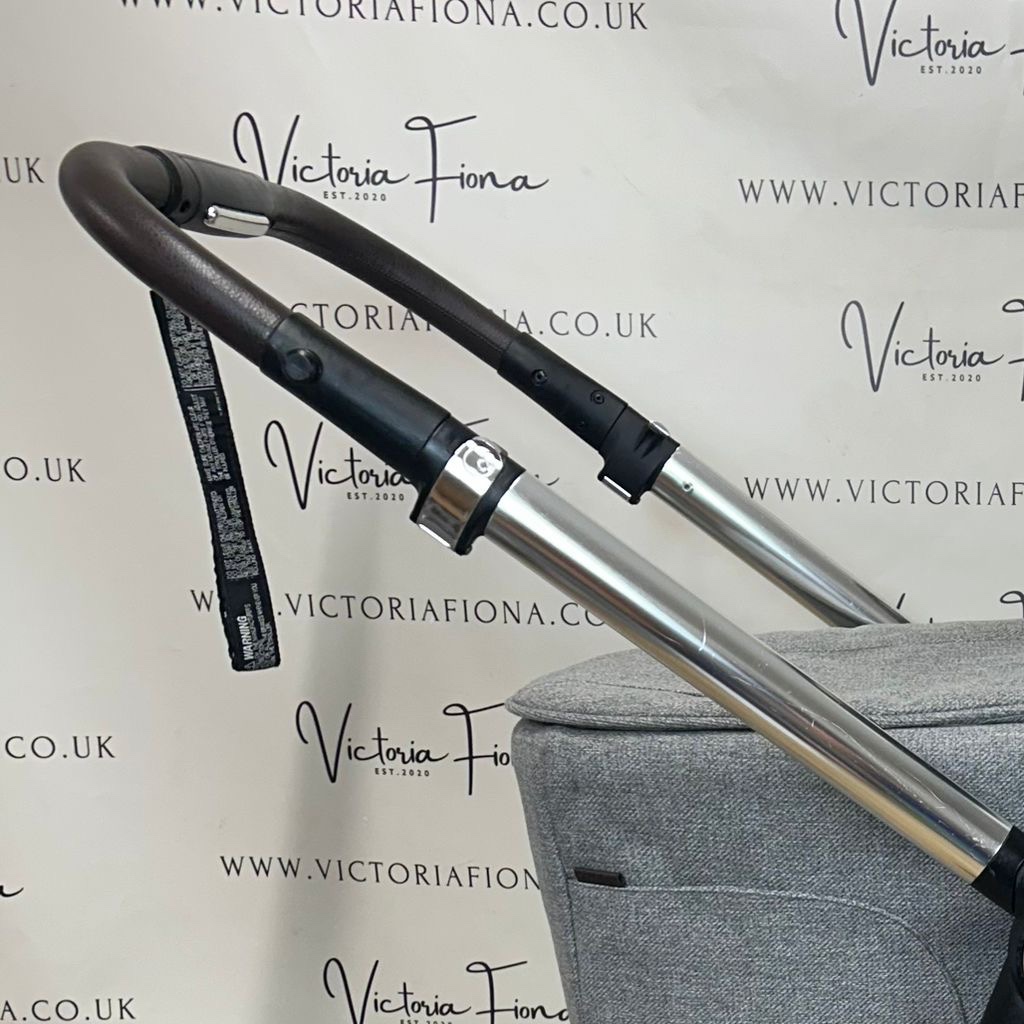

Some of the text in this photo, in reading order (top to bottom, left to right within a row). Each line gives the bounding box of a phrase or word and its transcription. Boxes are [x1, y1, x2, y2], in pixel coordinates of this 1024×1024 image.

[835, 0, 1006, 86] Victoria
[921, 65, 982, 75] EST.2020
[233, 112, 549, 224] Victoria Fiona
[323, 190, 387, 202] EST.2020
[841, 300, 1004, 392] Victoria
[922, 373, 982, 383] EST.2020
[347, 491, 405, 501] EST.2020
[237, 615, 255, 661] WARNING
[296, 701, 511, 796] Victoria Fio
[375, 768, 430, 777] EST.2020
